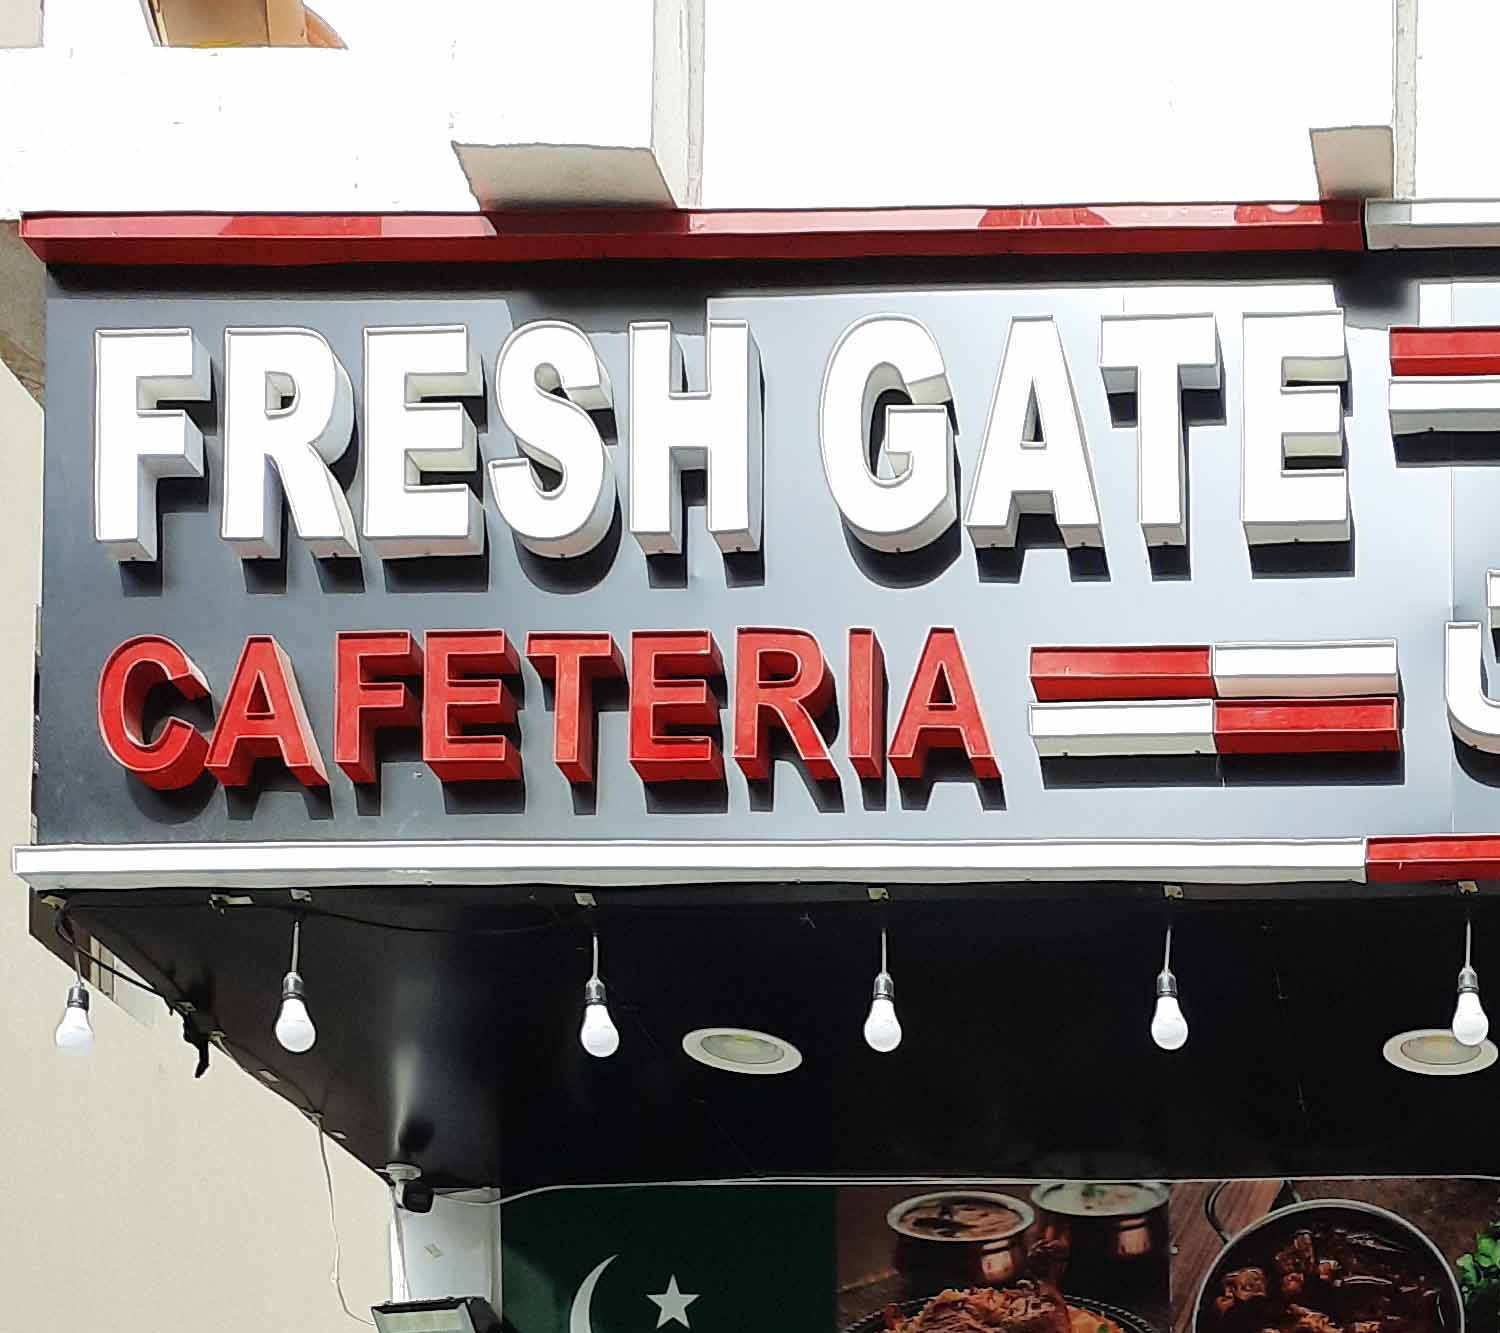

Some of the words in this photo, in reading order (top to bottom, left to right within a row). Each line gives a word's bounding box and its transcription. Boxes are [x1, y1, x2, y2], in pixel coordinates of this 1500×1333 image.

[94, 318, 765, 562] FRESH
[818, 306, 1352, 553] GATE
[97, 626, 1001, 791] CAFETERIA
